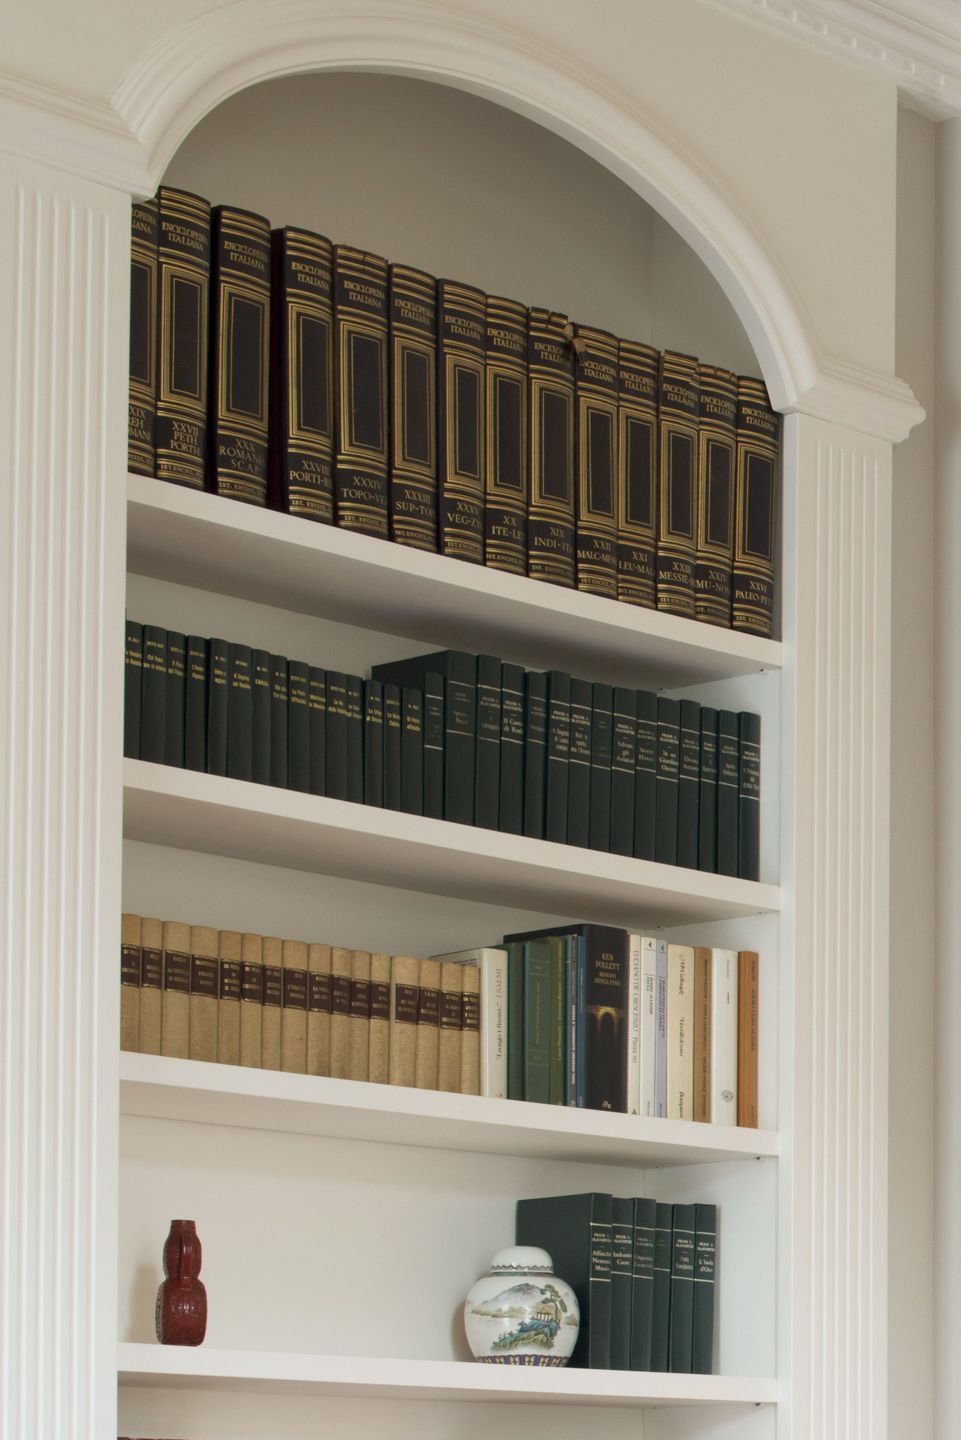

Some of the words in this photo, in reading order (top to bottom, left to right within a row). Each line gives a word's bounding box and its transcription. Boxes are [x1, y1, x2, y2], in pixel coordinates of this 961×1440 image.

[168, 232, 204, 252] ITALIANA
[230, 252, 265, 272] ITALIANA
[297, 273, 329, 292] ITALIANA
[349, 291, 383, 310] ITALIANA
[400, 308, 431, 326] ITALIANA
[450, 325, 482, 341] ITALIANA
[493, 336, 524, 353] ITALIANA
[745, 416, 776, 432] ITALIANA
[352, 475, 384, 490] XXXIV
[503, 514, 517, 527] XX
[601, 951, 614, 961] KEN
[595, 960, 621, 970] FOLLETT
